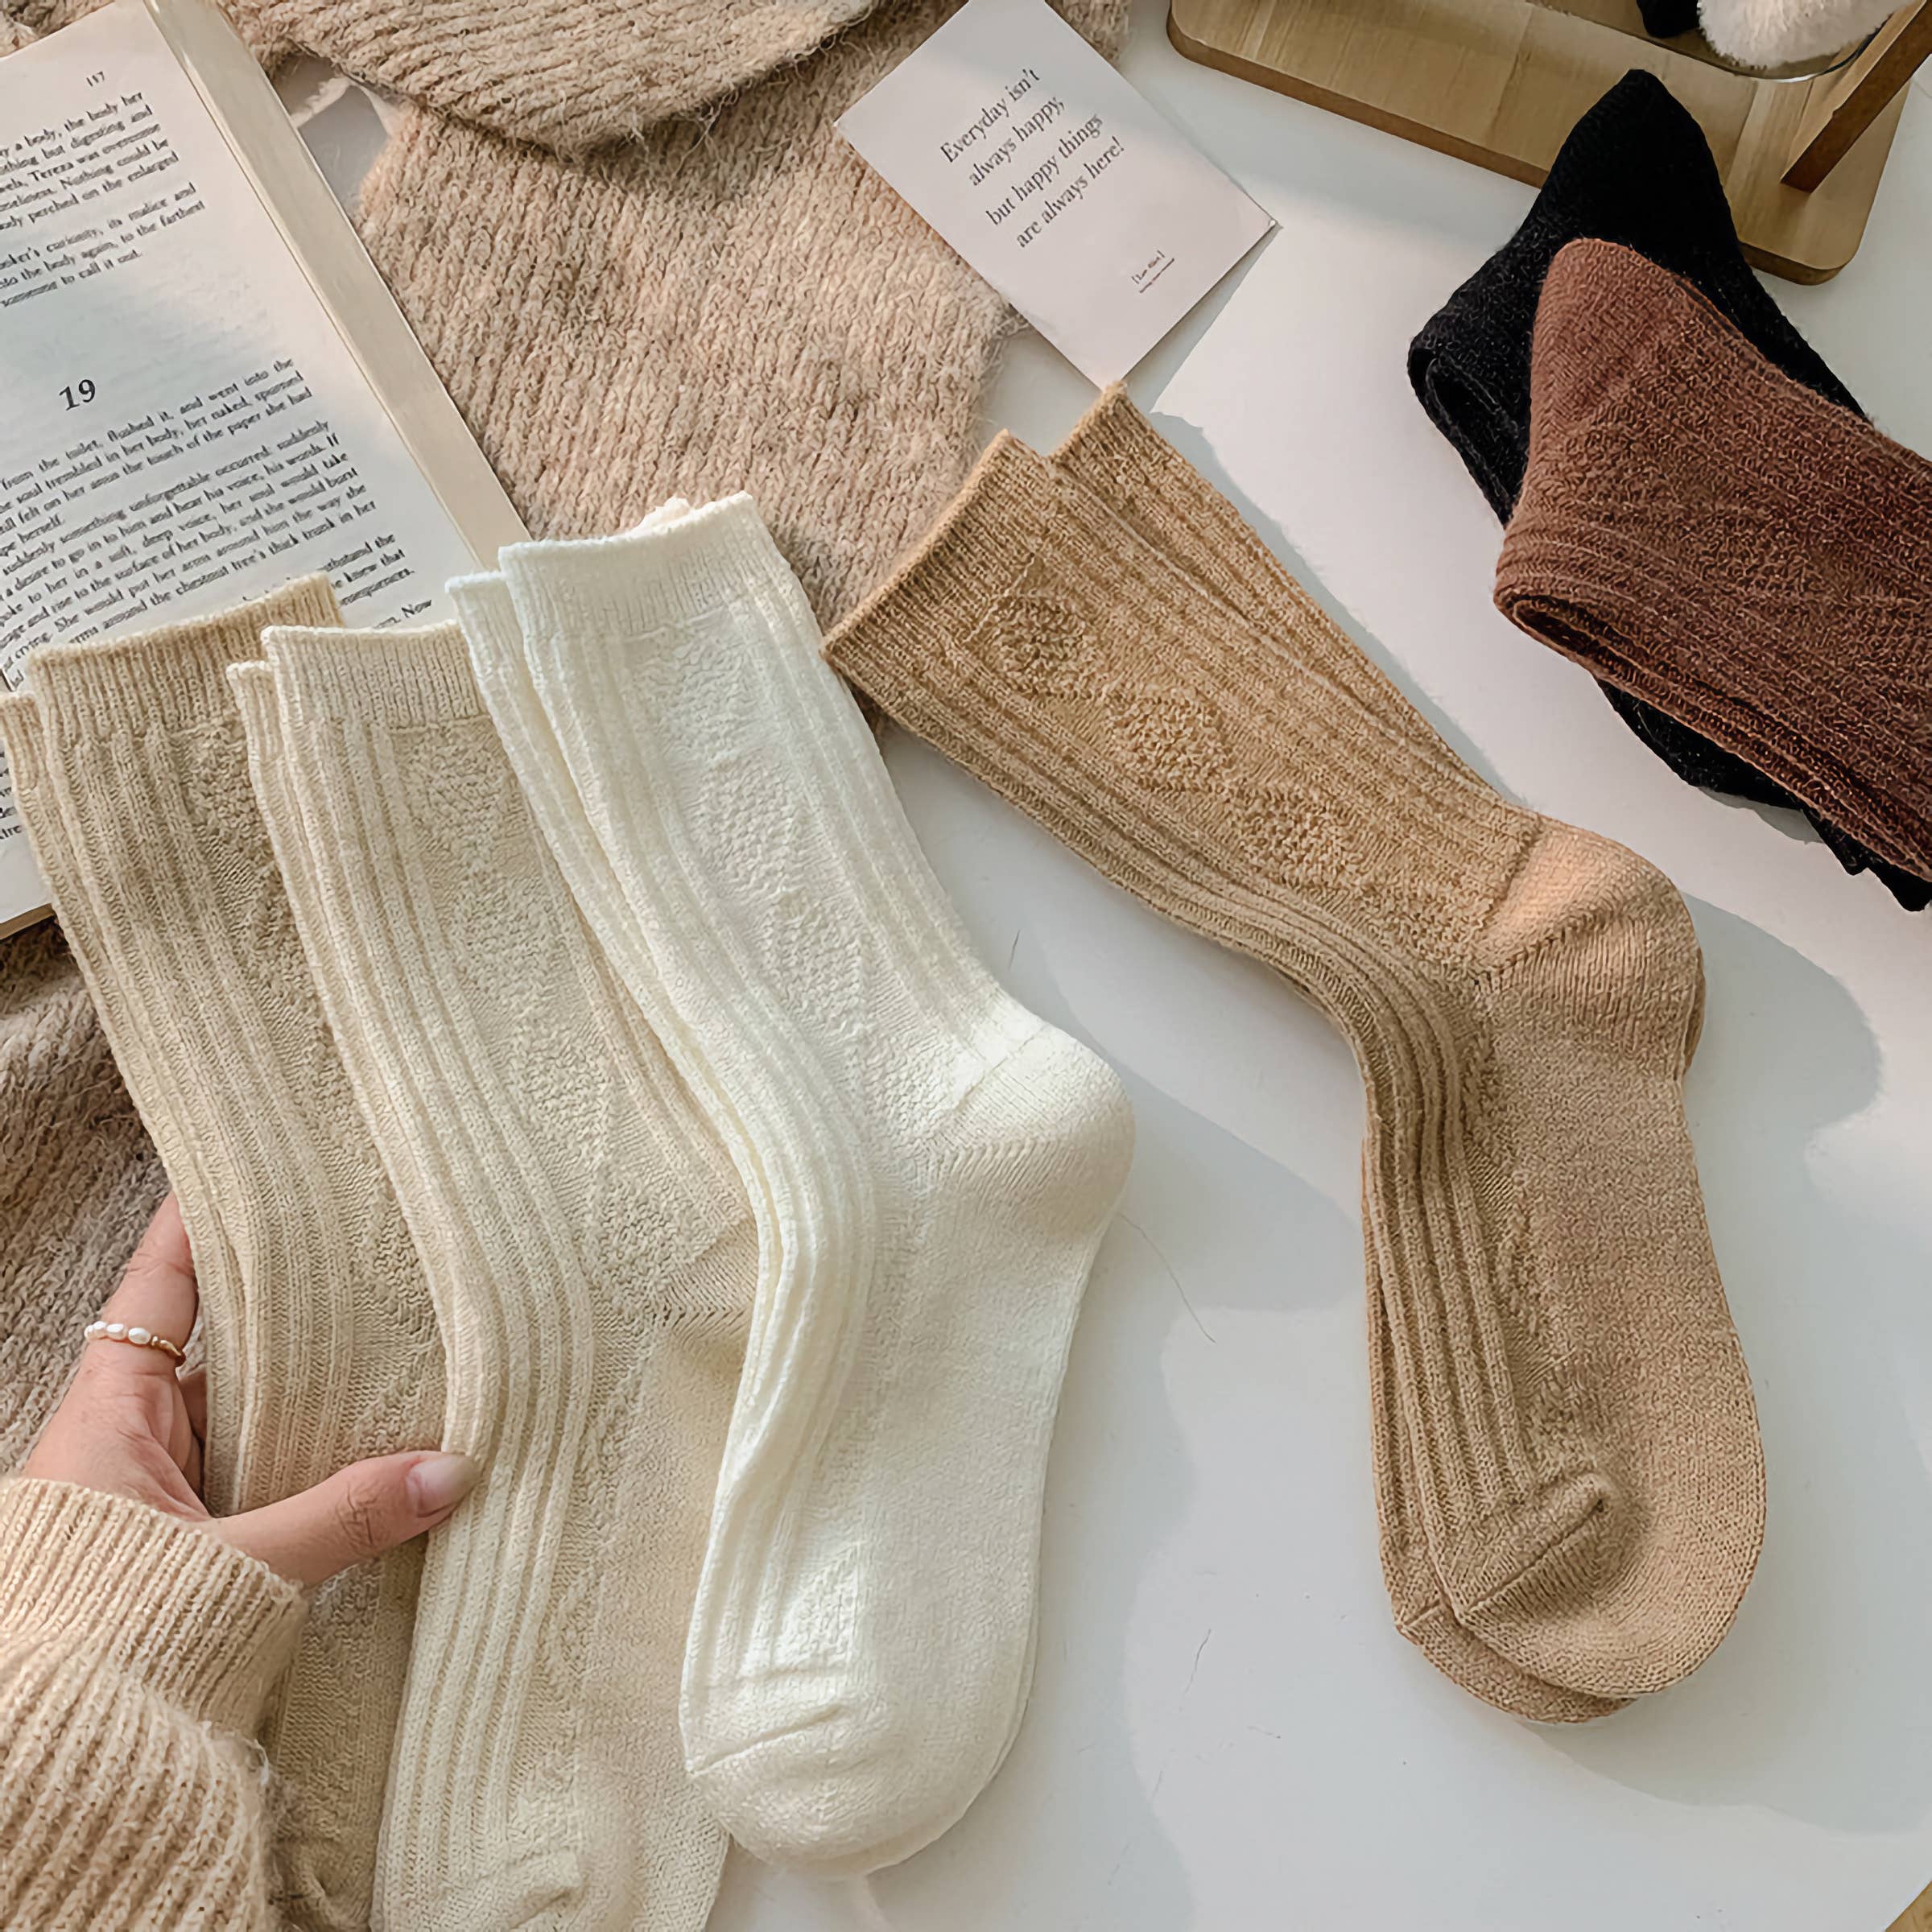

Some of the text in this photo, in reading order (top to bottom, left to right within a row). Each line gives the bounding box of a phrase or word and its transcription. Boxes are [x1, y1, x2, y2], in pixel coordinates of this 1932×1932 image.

[940, 69, 1040, 163] Everyday isn't
[969, 97, 1064, 186] always happy,
[985, 114, 1102, 225] but happy things
[1017, 136, 1125, 248] are always here!
[59, 379, 96, 411] 19
